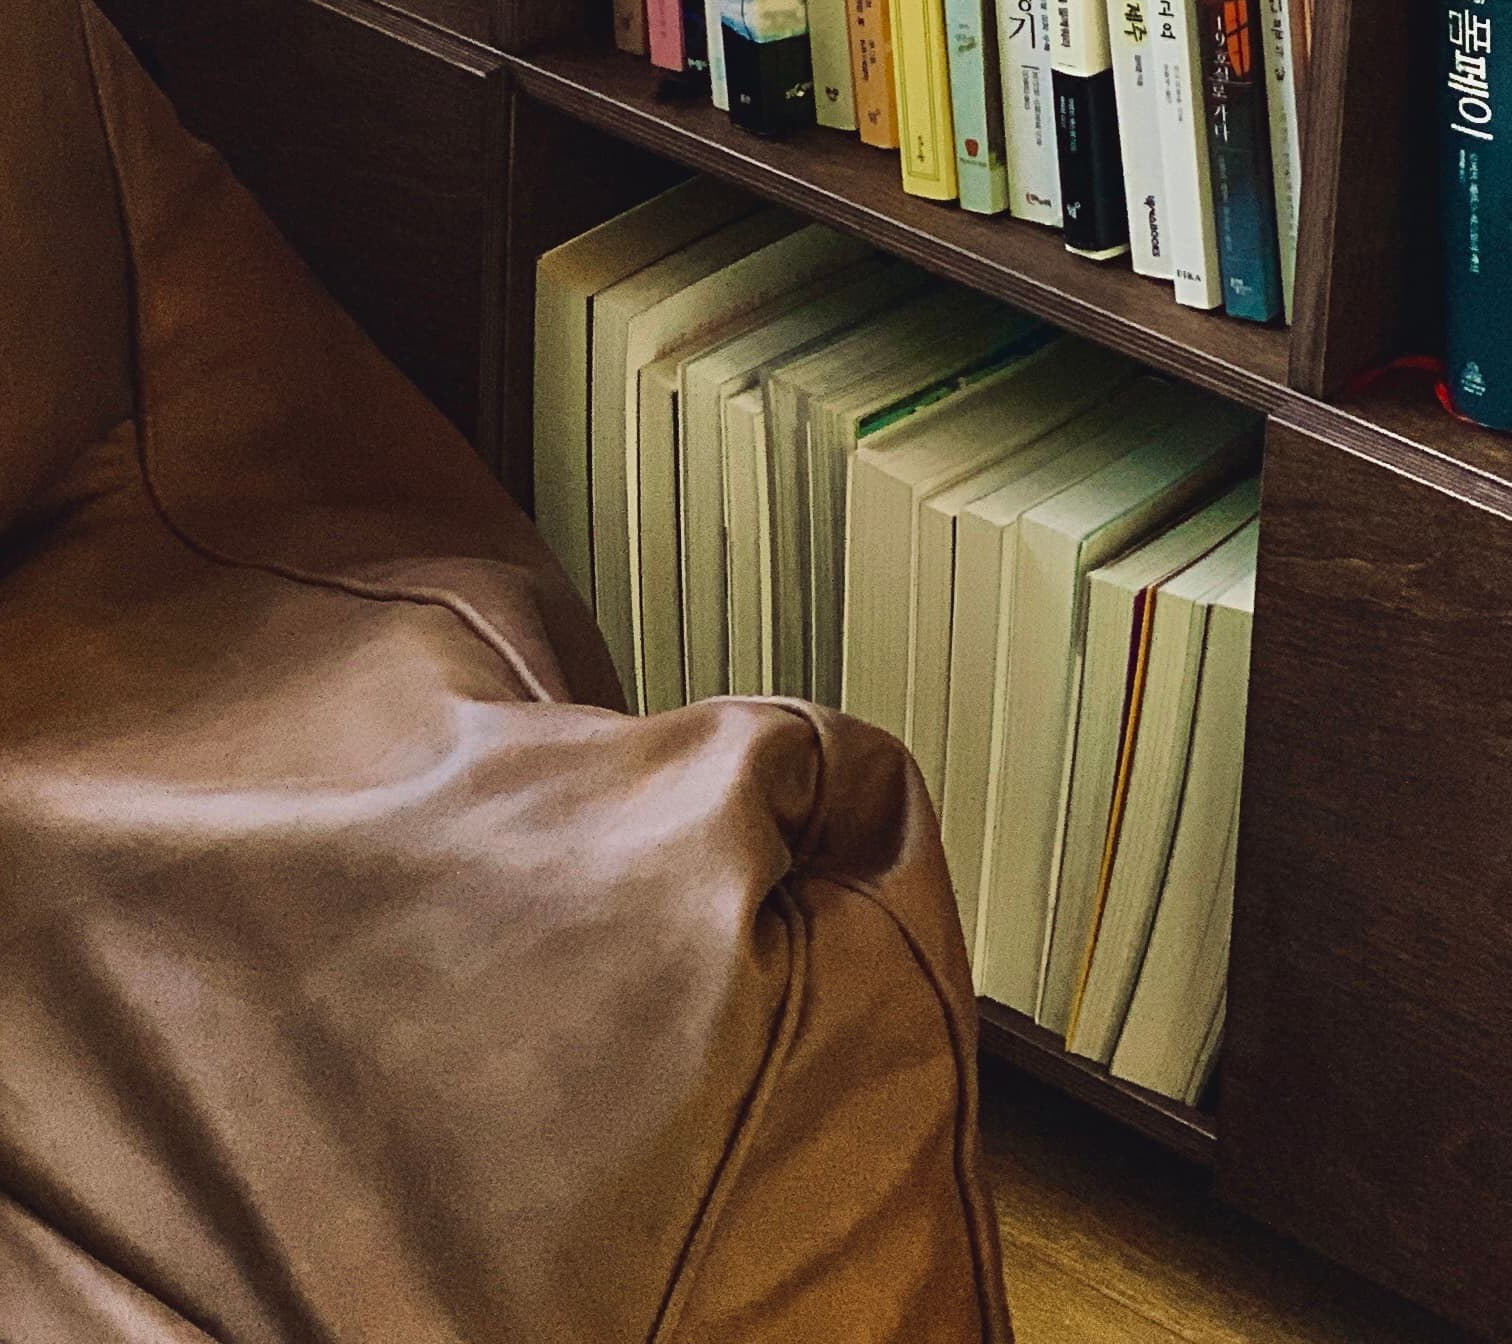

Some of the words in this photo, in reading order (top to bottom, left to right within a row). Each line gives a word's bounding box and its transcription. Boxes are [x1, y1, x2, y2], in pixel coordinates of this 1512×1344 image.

[1122, 0, 1149, 44] 제주
[1448, 9, 1494, 141] 폼페이
[1214, 103, 1229, 145] 가다
